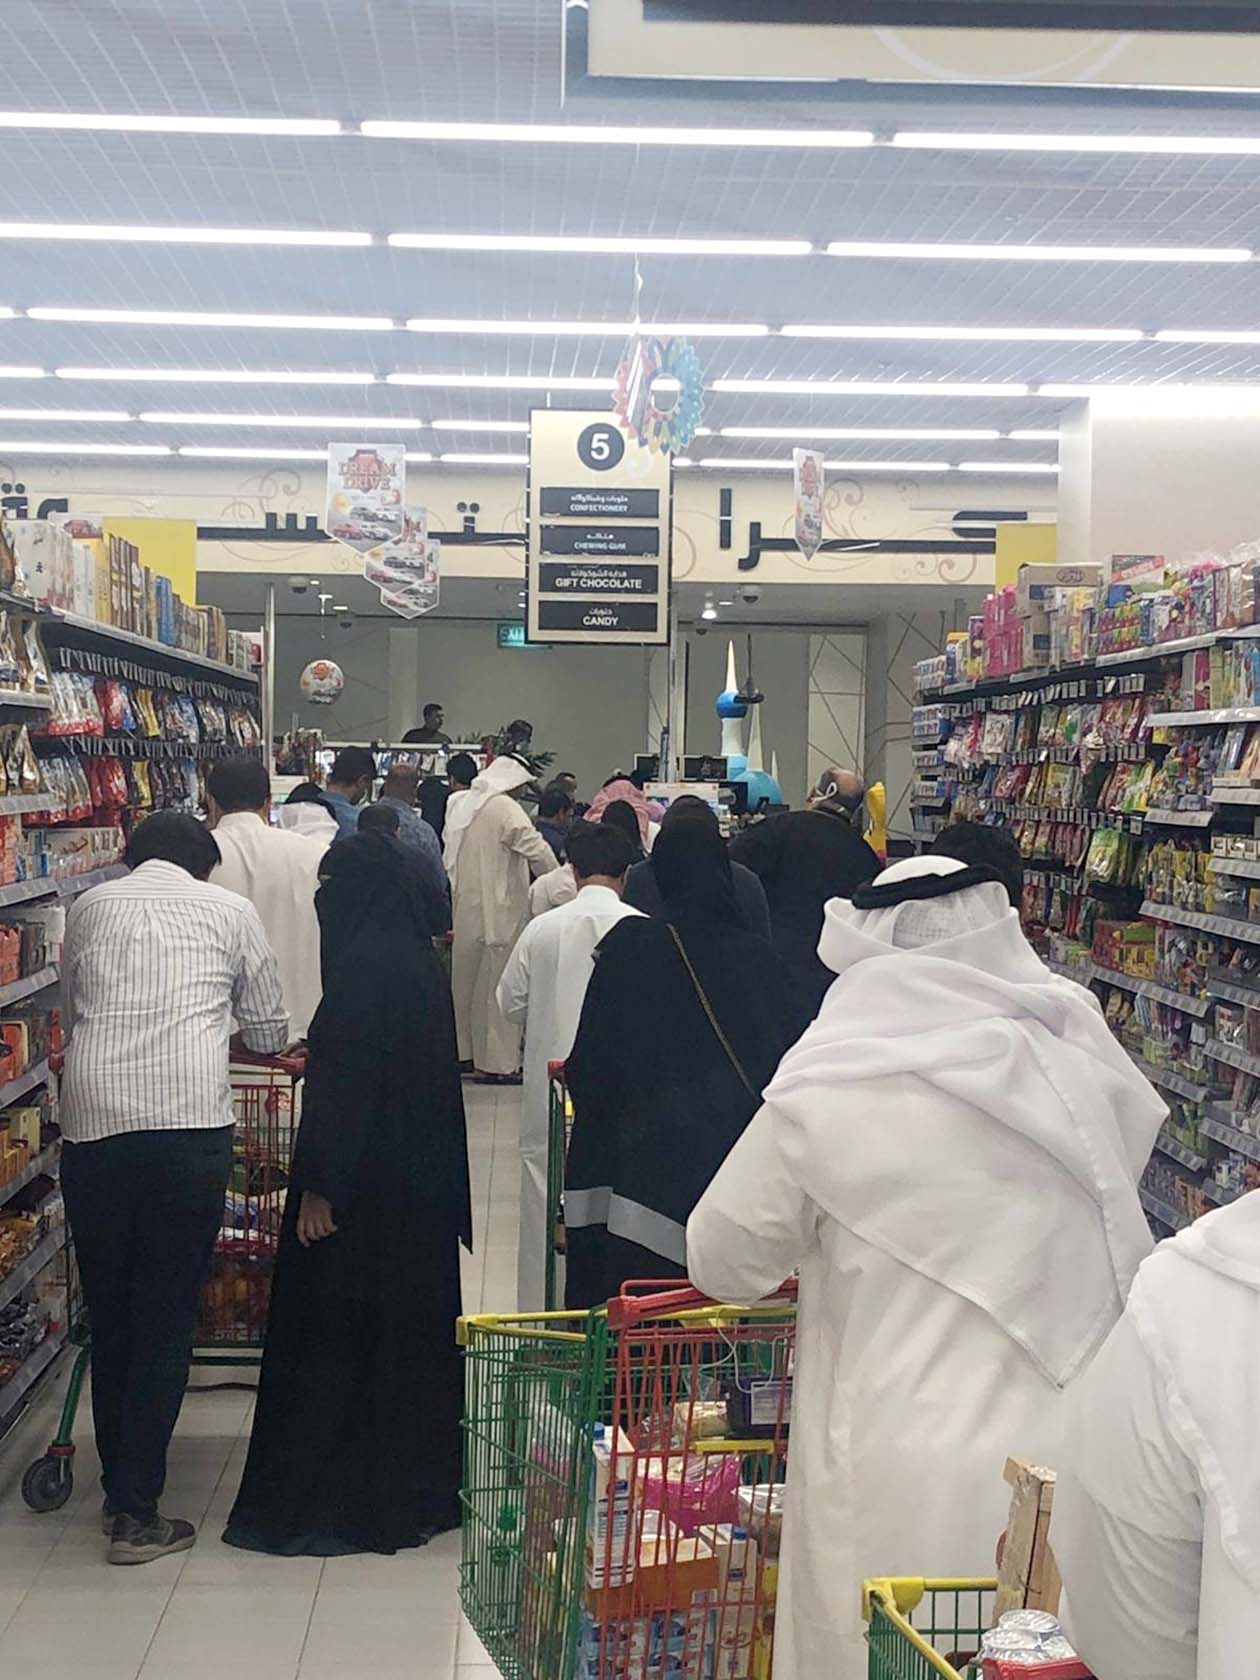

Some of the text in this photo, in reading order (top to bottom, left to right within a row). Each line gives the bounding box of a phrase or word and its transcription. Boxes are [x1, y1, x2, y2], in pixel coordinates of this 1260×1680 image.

[590, 433, 610, 460] 5
[338, 461, 397, 477] DREAM
[343, 476, 391, 490] DRIVE
[570, 504, 628, 512] CONFECTIONERY
[574, 542, 626, 550] CHEWING GUM
[555, 578, 642, 589] GIFT CHOCOLATE
[583, 616, 619, 626] CANDY
